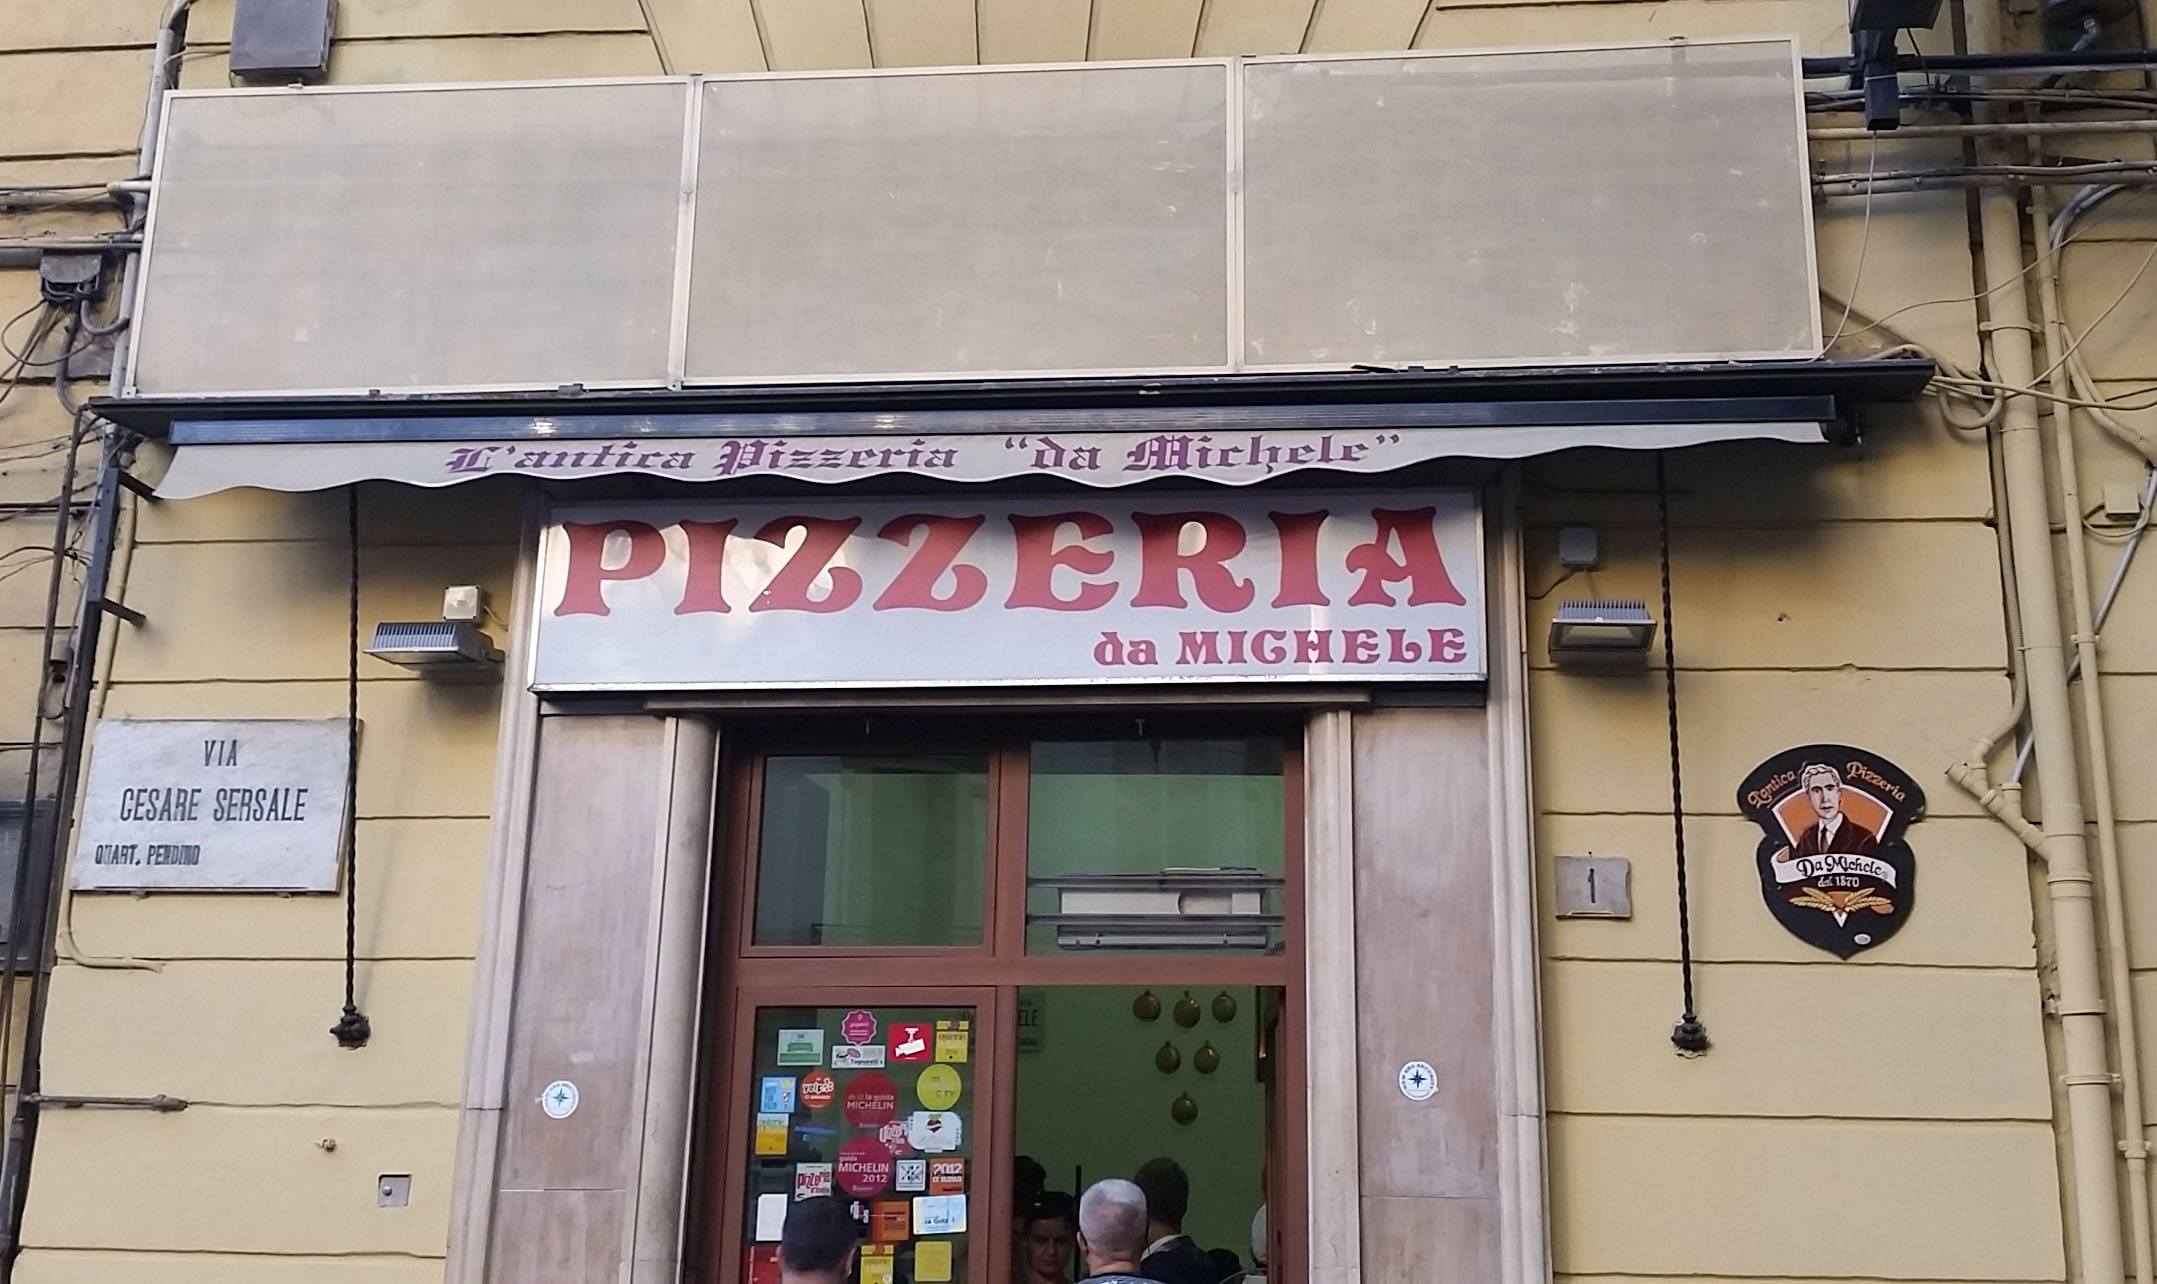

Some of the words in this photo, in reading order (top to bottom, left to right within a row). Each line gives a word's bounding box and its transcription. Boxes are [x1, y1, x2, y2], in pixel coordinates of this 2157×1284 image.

[445, 441, 696, 473] L'antica
[712, 438, 959, 476] Pizzeria
[553, 505, 1467, 617] PIZZERIA
[1093, 631, 1159, 666] da
[1175, 627, 1468, 665] MICHELE
[203, 739, 239, 767] VIA
[1845, 760, 1906, 803] Pizzeria
[119, 788, 202, 822] CESARE
[212, 788, 309, 822] SERSALE
[94, 844, 141, 866] QUART.
[146, 844, 201, 866] PENDINO
[1796, 855, 1823, 877] Da
[1823, 854, 1882, 876] Michele
[1587, 867, 1596, 904] 1
[1835, 875, 1860, 888] 1870
[846, 1101, 894, 1111] MICHELIN
[838, 1162, 889, 1174] MICHELIN
[862, 1174, 888, 1184] 2012
[932, 1163, 963, 1176] 2012
